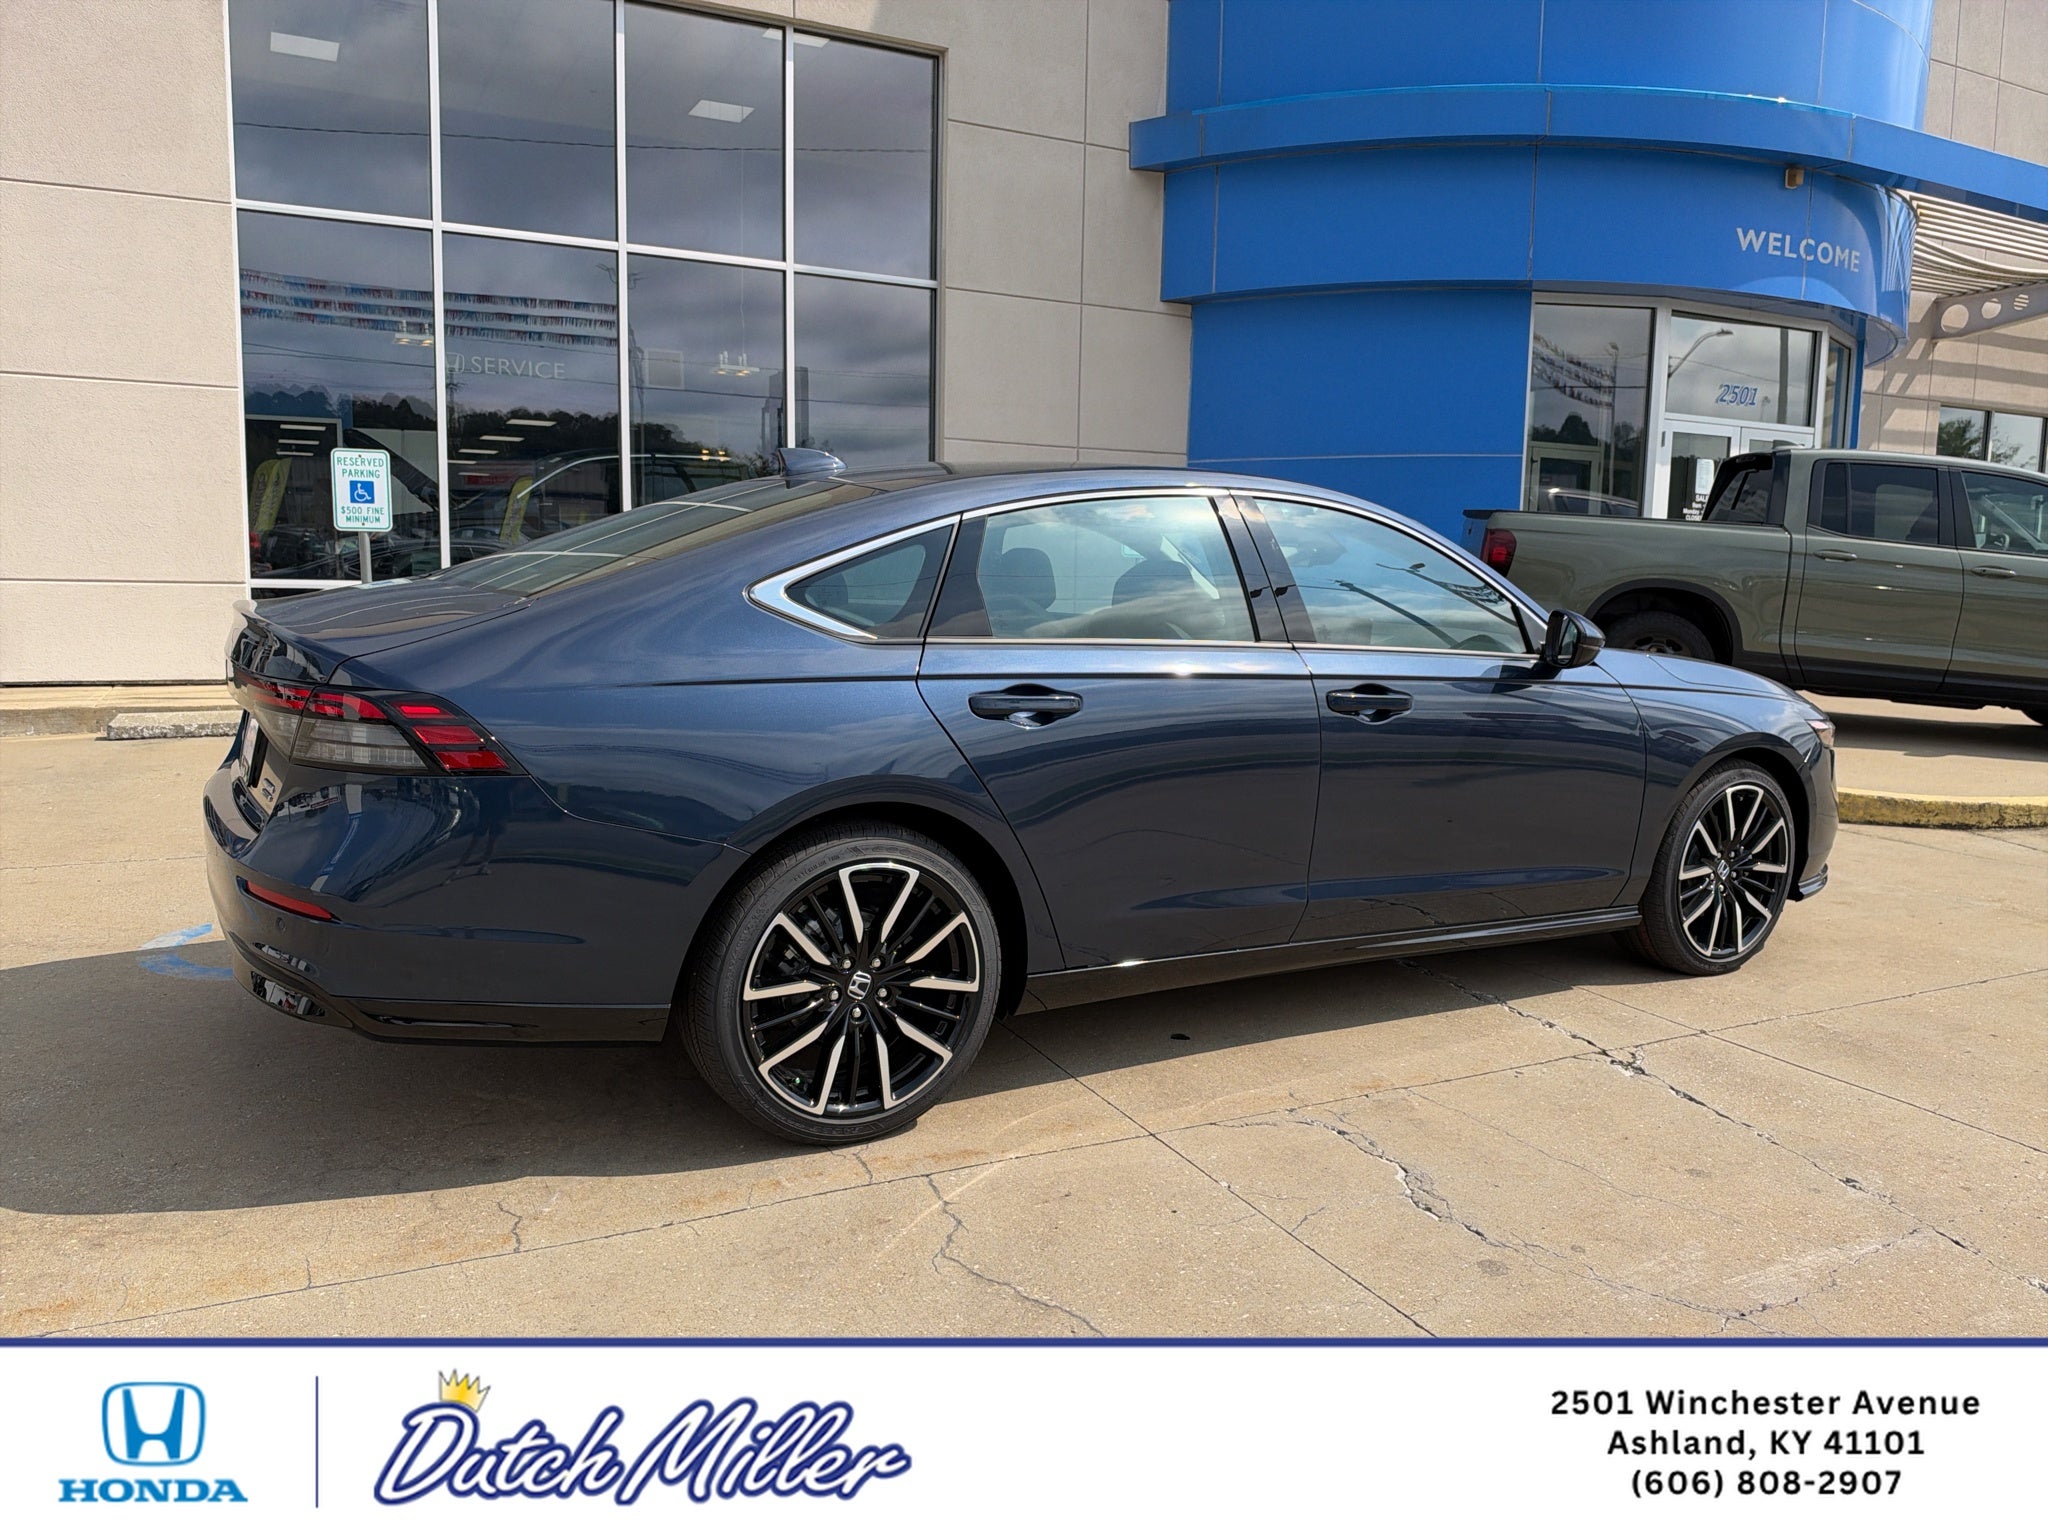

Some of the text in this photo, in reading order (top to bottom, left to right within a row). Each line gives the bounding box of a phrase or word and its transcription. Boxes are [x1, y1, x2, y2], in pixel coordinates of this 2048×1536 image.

[1736, 227, 1860, 272] WELCOME
[471, 356, 566, 379] SERVICE
[1718, 384, 1758, 406] 2501
[336, 456, 384, 467] RESERVED
[341, 468, 380, 479] PARKING
[341, 506, 384, 515] $500 FINE
[345, 515, 381, 524] MINIMUM
